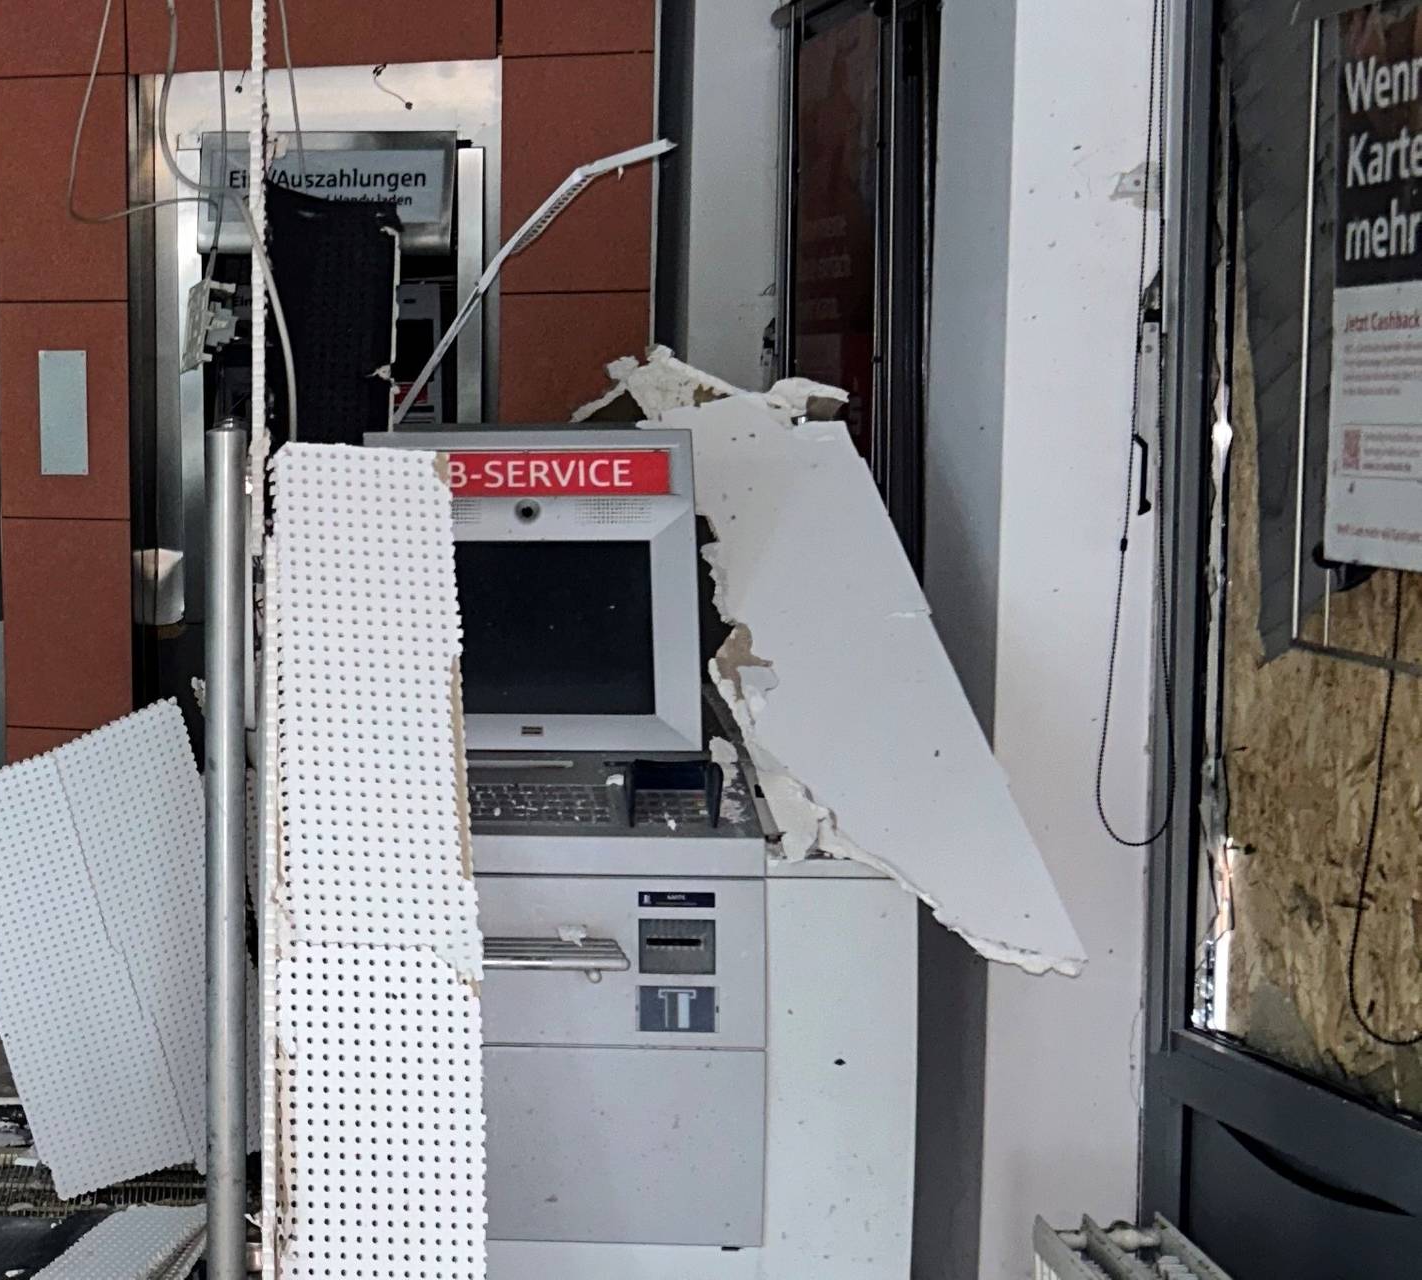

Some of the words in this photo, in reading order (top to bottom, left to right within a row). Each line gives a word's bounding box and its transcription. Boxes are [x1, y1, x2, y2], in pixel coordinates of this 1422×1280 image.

[229, 168, 427, 192] Ei/Auszahlungen
[1344, 198, 1422, 261] mehr
[1371, 309, 1421, 331] Cashback
[448, 459, 633, 488] B-SERVICE
